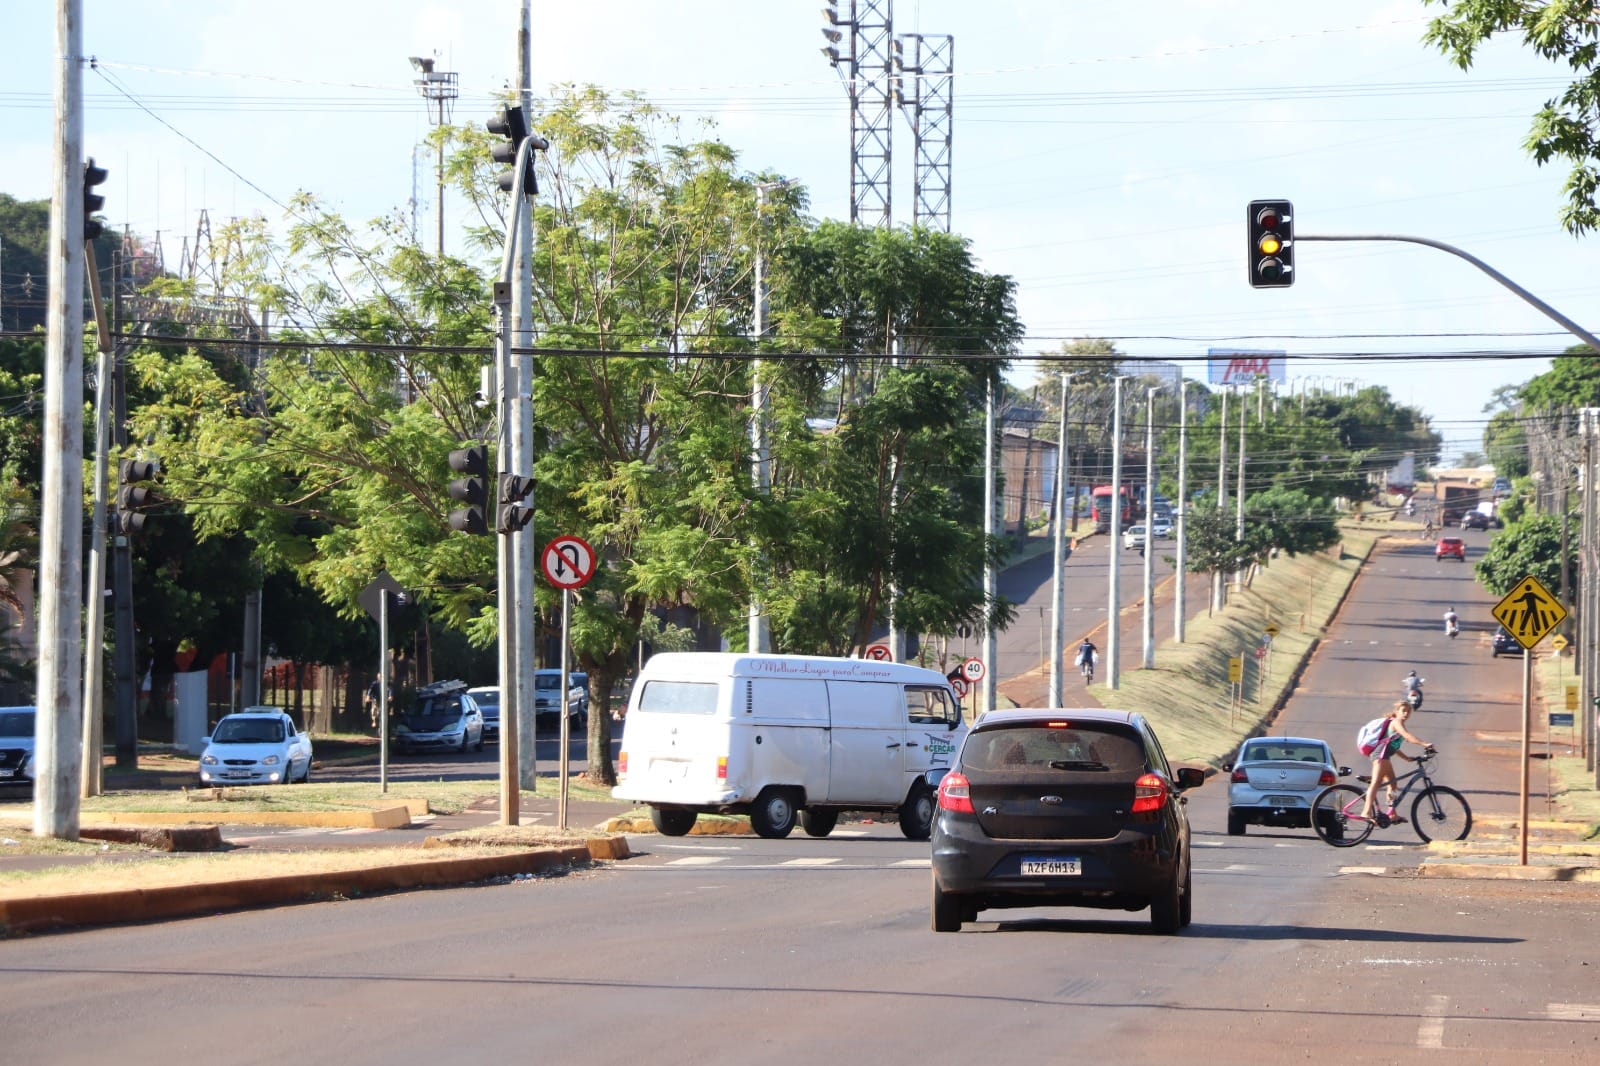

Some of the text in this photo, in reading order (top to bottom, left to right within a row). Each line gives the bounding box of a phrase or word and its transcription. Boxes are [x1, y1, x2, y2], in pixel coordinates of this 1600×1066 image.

[1224, 353, 1270, 382] MAX
[832, 668, 852, 677] para
[852, 664, 891, 679] Comprar
[967, 663, 980, 673] 40
[1027, 862, 1076, 874] AZF6H13
